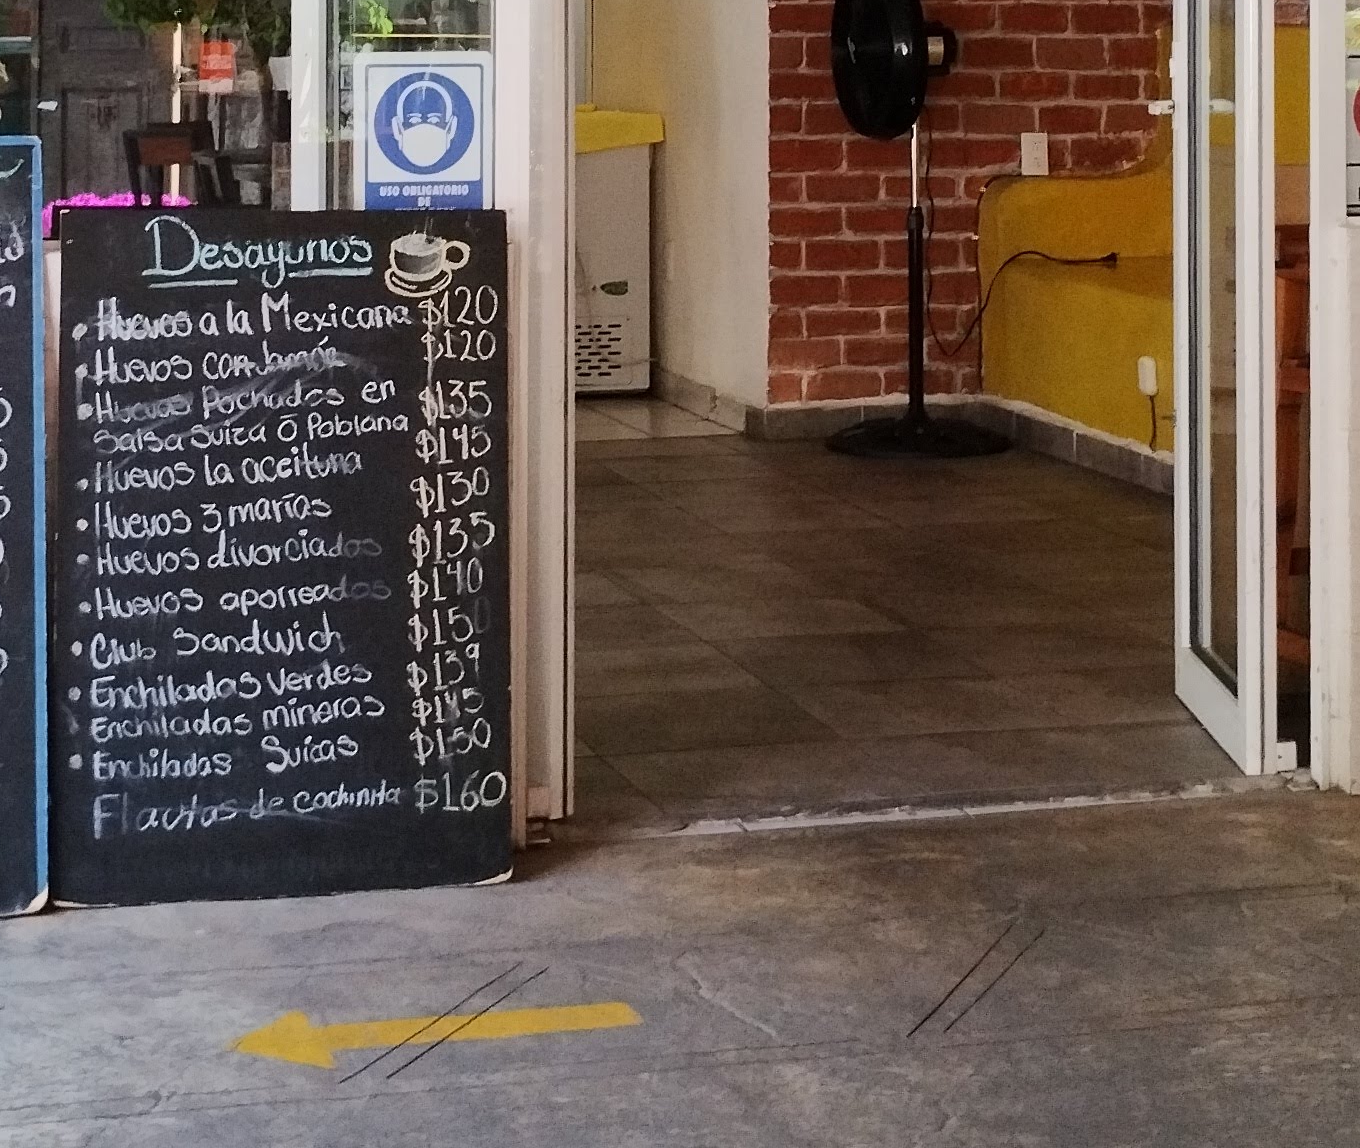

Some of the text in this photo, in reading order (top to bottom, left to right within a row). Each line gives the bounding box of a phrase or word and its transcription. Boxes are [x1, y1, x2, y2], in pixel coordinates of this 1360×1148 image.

[379, 184, 469, 197] USO OBLIGATORIO
[417, 197, 432, 207] DE
[142, 215, 373, 288] Desayunos
[198, 308, 219, 336] a
[226, 299, 255, 336] la
[261, 290, 413, 333] Mexicana
[417, 284, 499, 327] $120
[94, 346, 193, 386] Huevos
[420, 329, 497, 363] $120
[361, 379, 397, 405] en
[418, 379, 493, 426] $135
[92, 427, 185, 456] Salsa
[308, 412, 410, 441] Poblana
[415, 424, 493, 466] $145
[94, 444, 364, 494] Huevos la aceituna
[409, 466, 490, 519] $130
[94, 501, 193, 540] Huevos
[200, 501, 222, 533] 3
[408, 510, 497, 568] $135
[96, 528, 383, 576] Huevos divorciados
[95, 572, 392, 621] Huevos aporreados
[407, 557, 485, 609] $140
[89, 632, 157, 671] Club
[89, 670, 263, 709] Enchiladas
[90, 694, 386, 743] Enchiladas mineras
[408, 717, 492, 767] $150
[248, 787, 285, 820] de
[414, 770, 508, 814] $160
